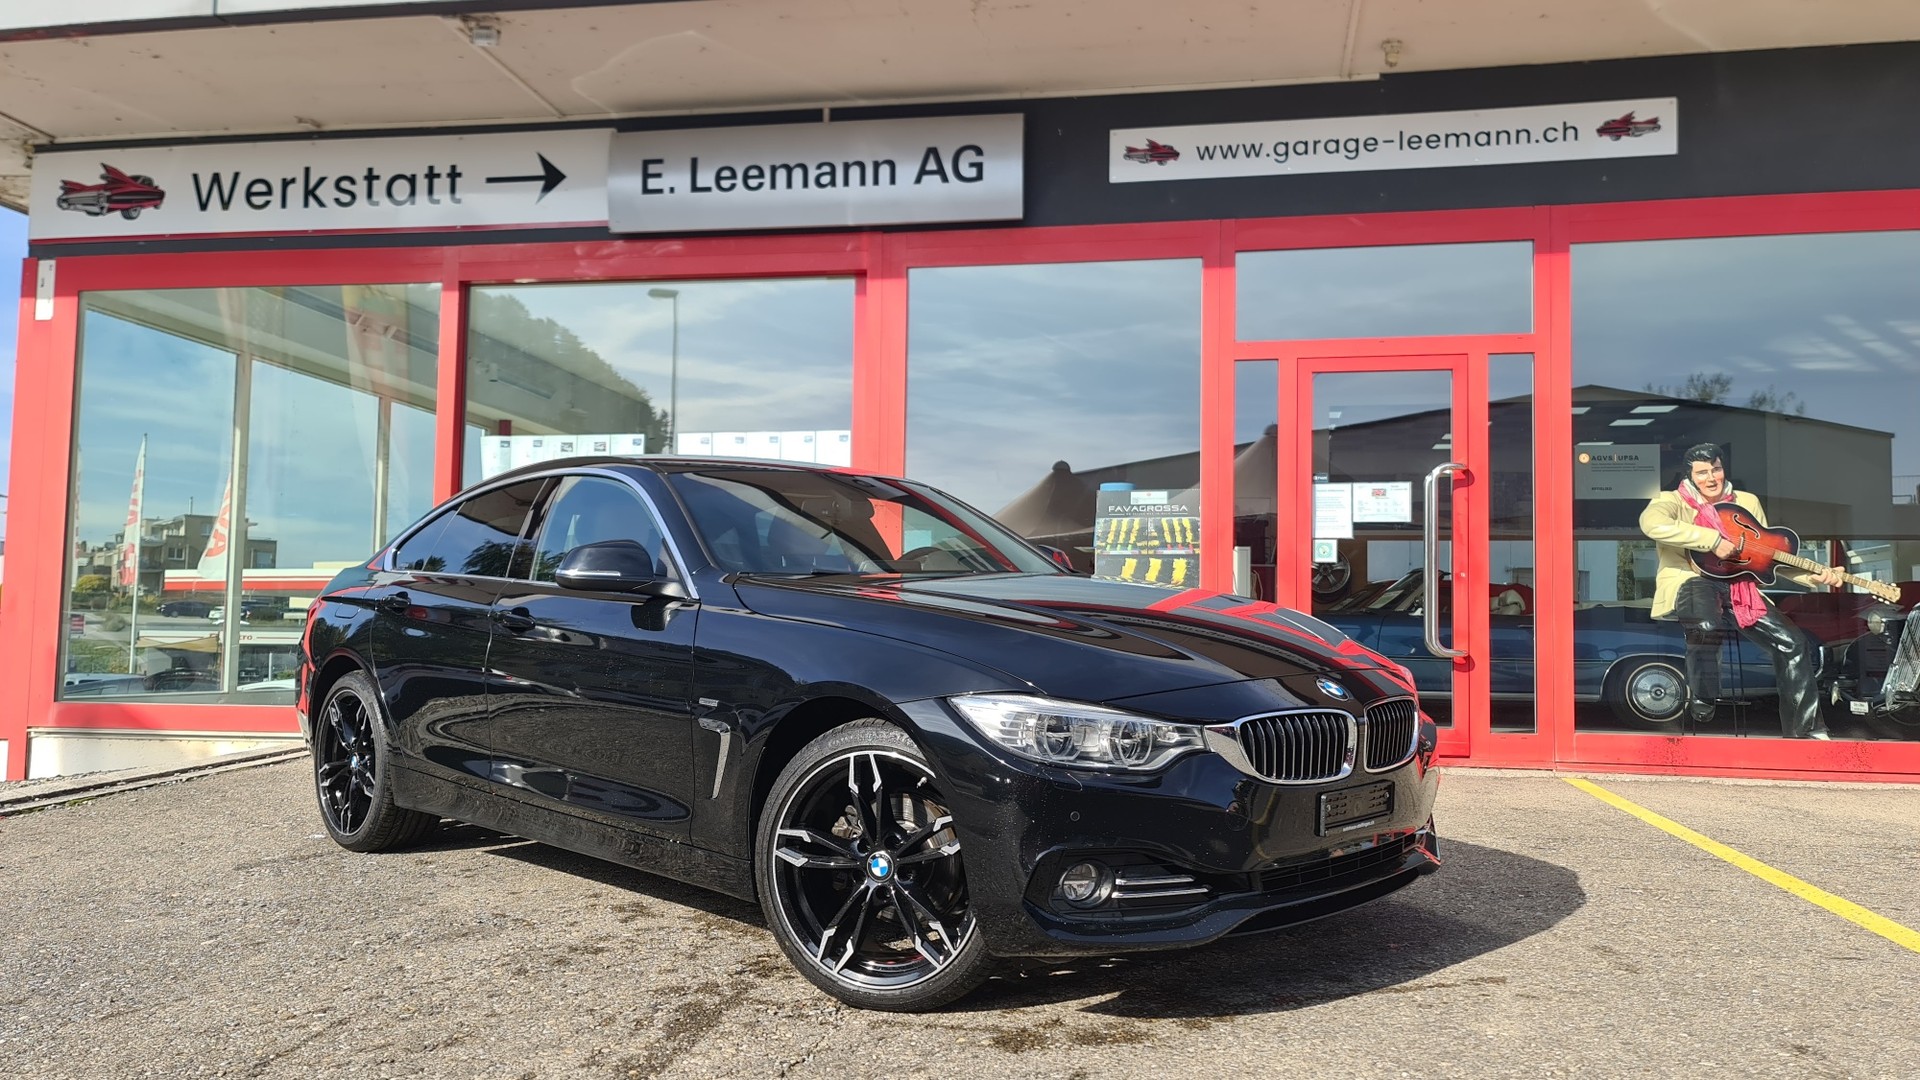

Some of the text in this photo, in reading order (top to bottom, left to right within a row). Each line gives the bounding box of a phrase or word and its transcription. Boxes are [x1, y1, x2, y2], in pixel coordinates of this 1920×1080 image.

[1196, 121, 1580, 165] www.garage-leemann.ch
[191, 163, 463, 213] Werkstatt
[640, 144, 985, 195] E. Leemann AG
[1108, 504, 1188, 513] FAVAGROSSA
